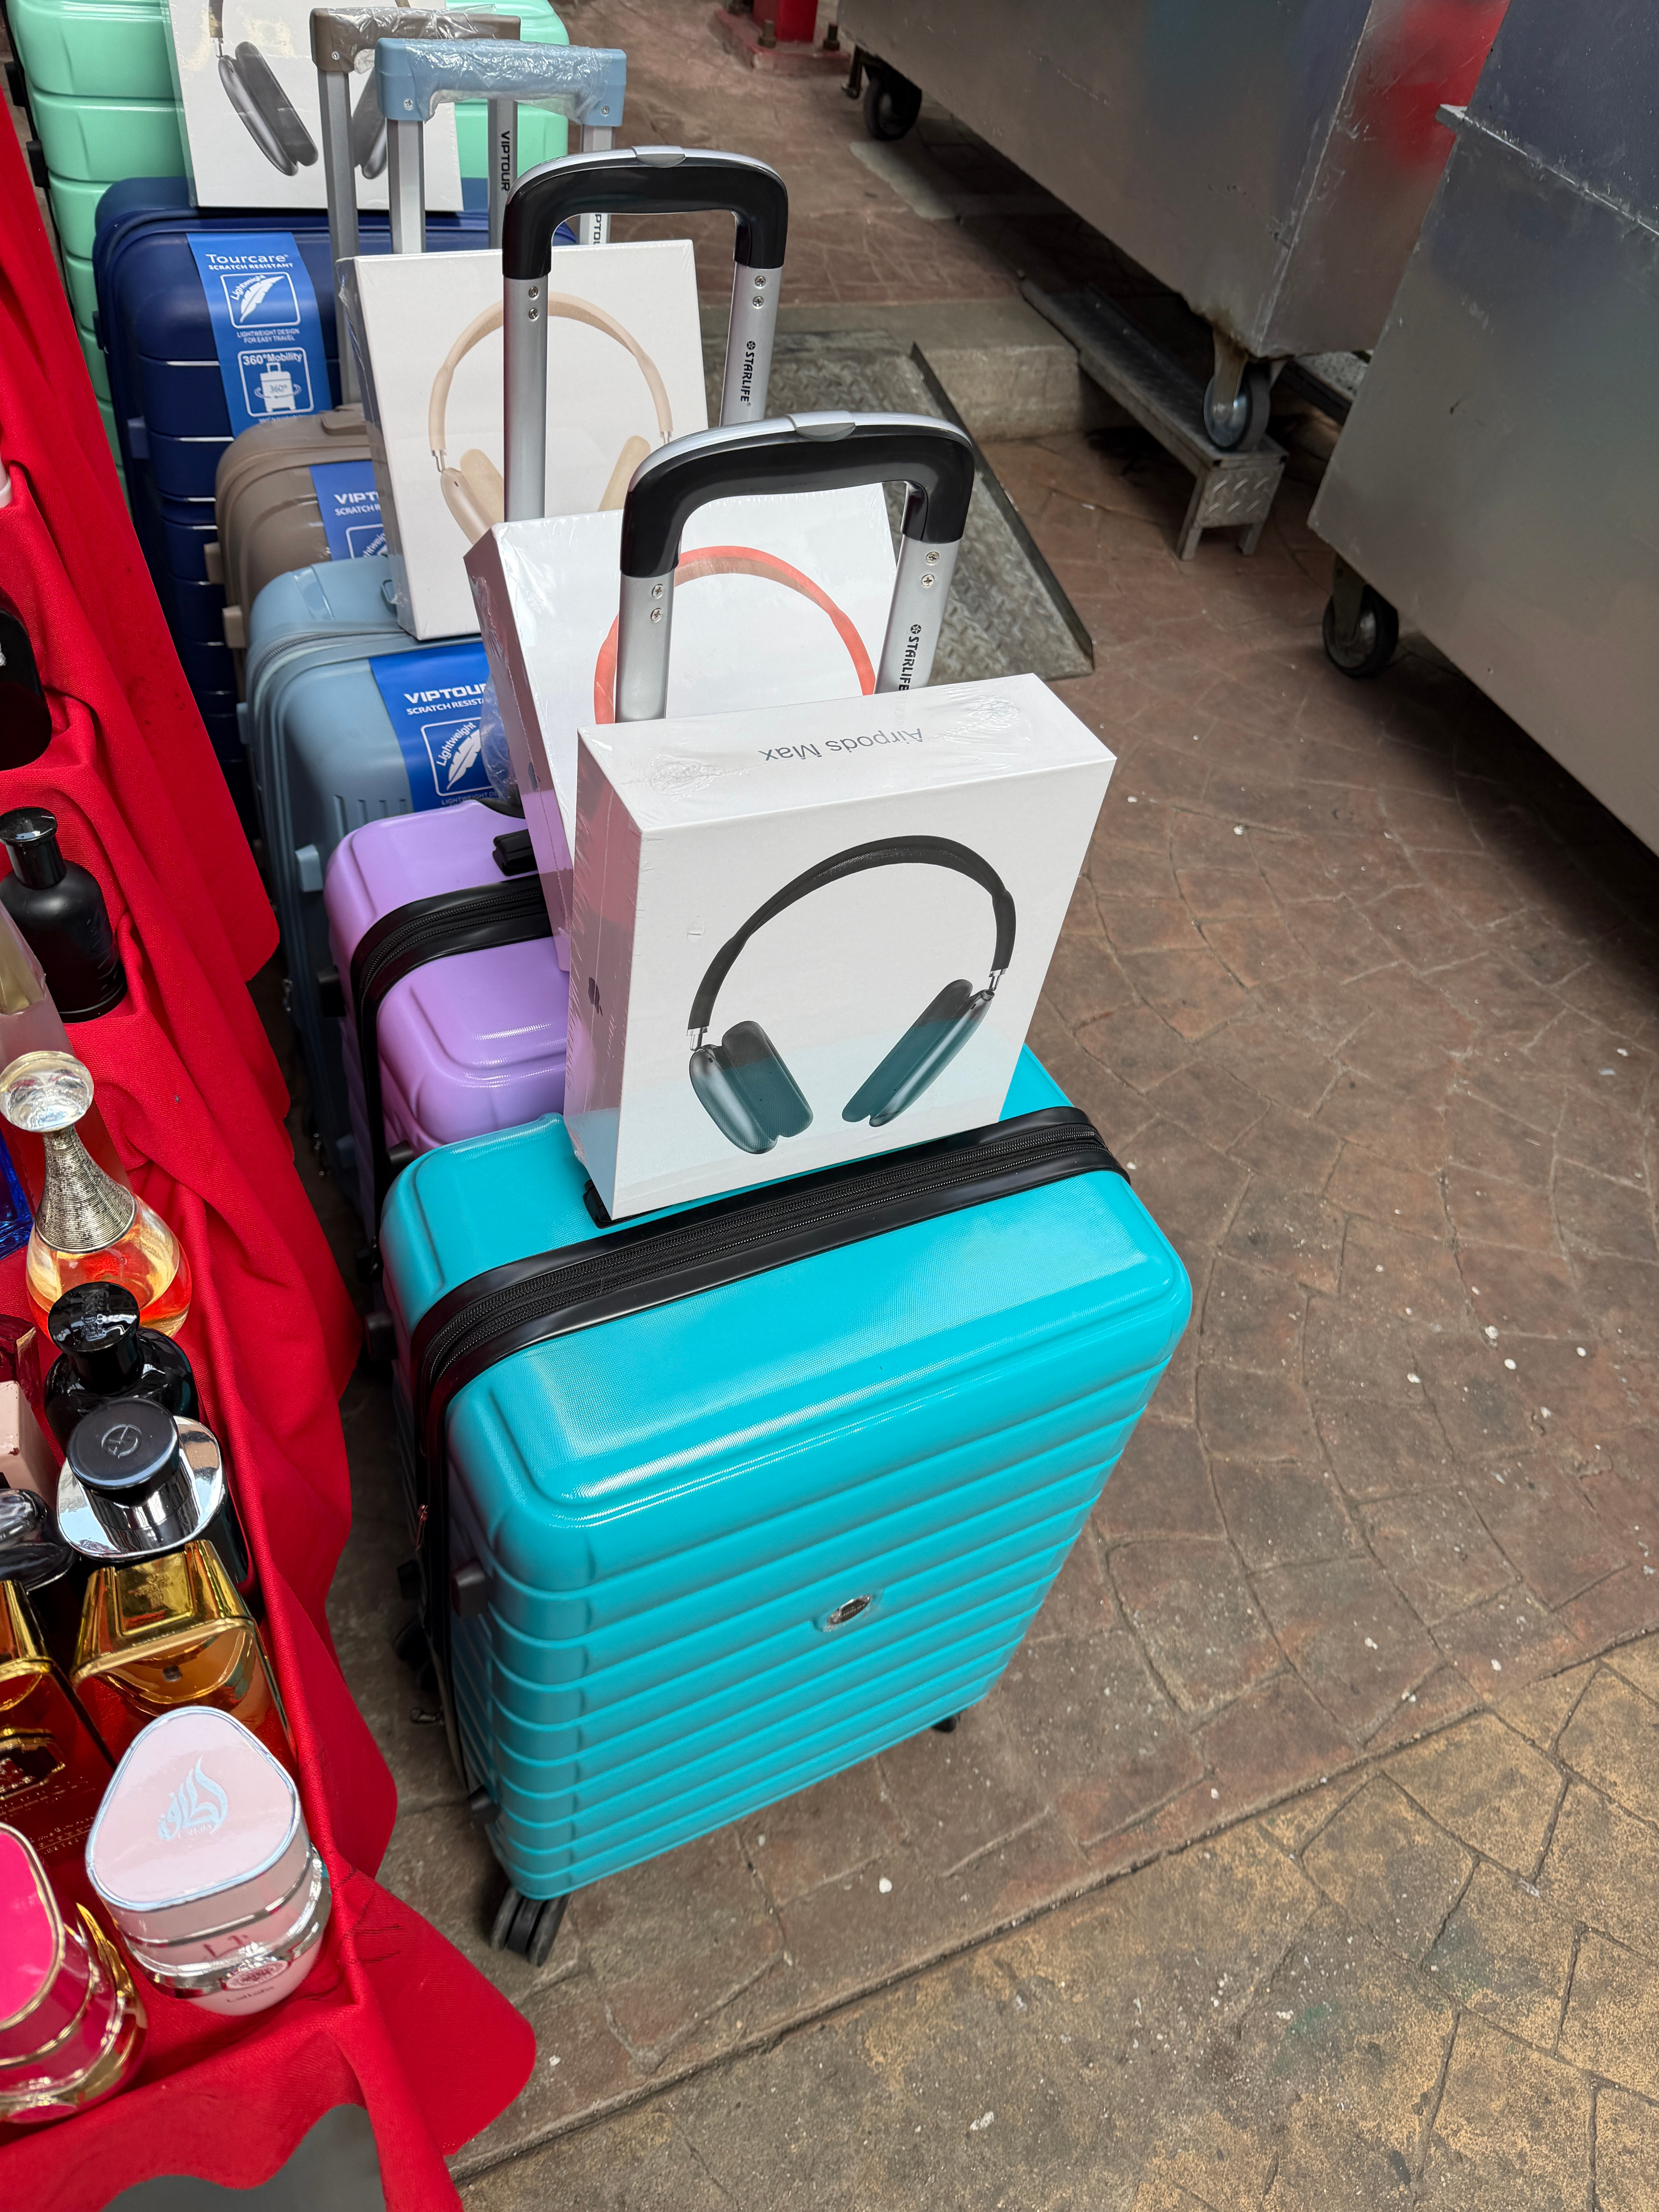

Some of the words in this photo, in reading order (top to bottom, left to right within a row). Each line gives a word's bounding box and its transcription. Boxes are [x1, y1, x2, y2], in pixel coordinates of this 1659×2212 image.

[501, 131, 510, 191] VIPTOUR
[230, 274, 266, 301] Lightweight
[237, 329, 276, 338] LIGHTWEIGHT
[334, 491, 379, 505] VIPT
[335, 505, 374, 516] SCRATCH
[898, 636, 919, 690] STARLIFE
[406, 703, 452, 715] SCRATCH
[436, 722, 476, 766] Lightweight
[825, 728, 923, 753] Airpods
[758, 744, 823, 761] Max
